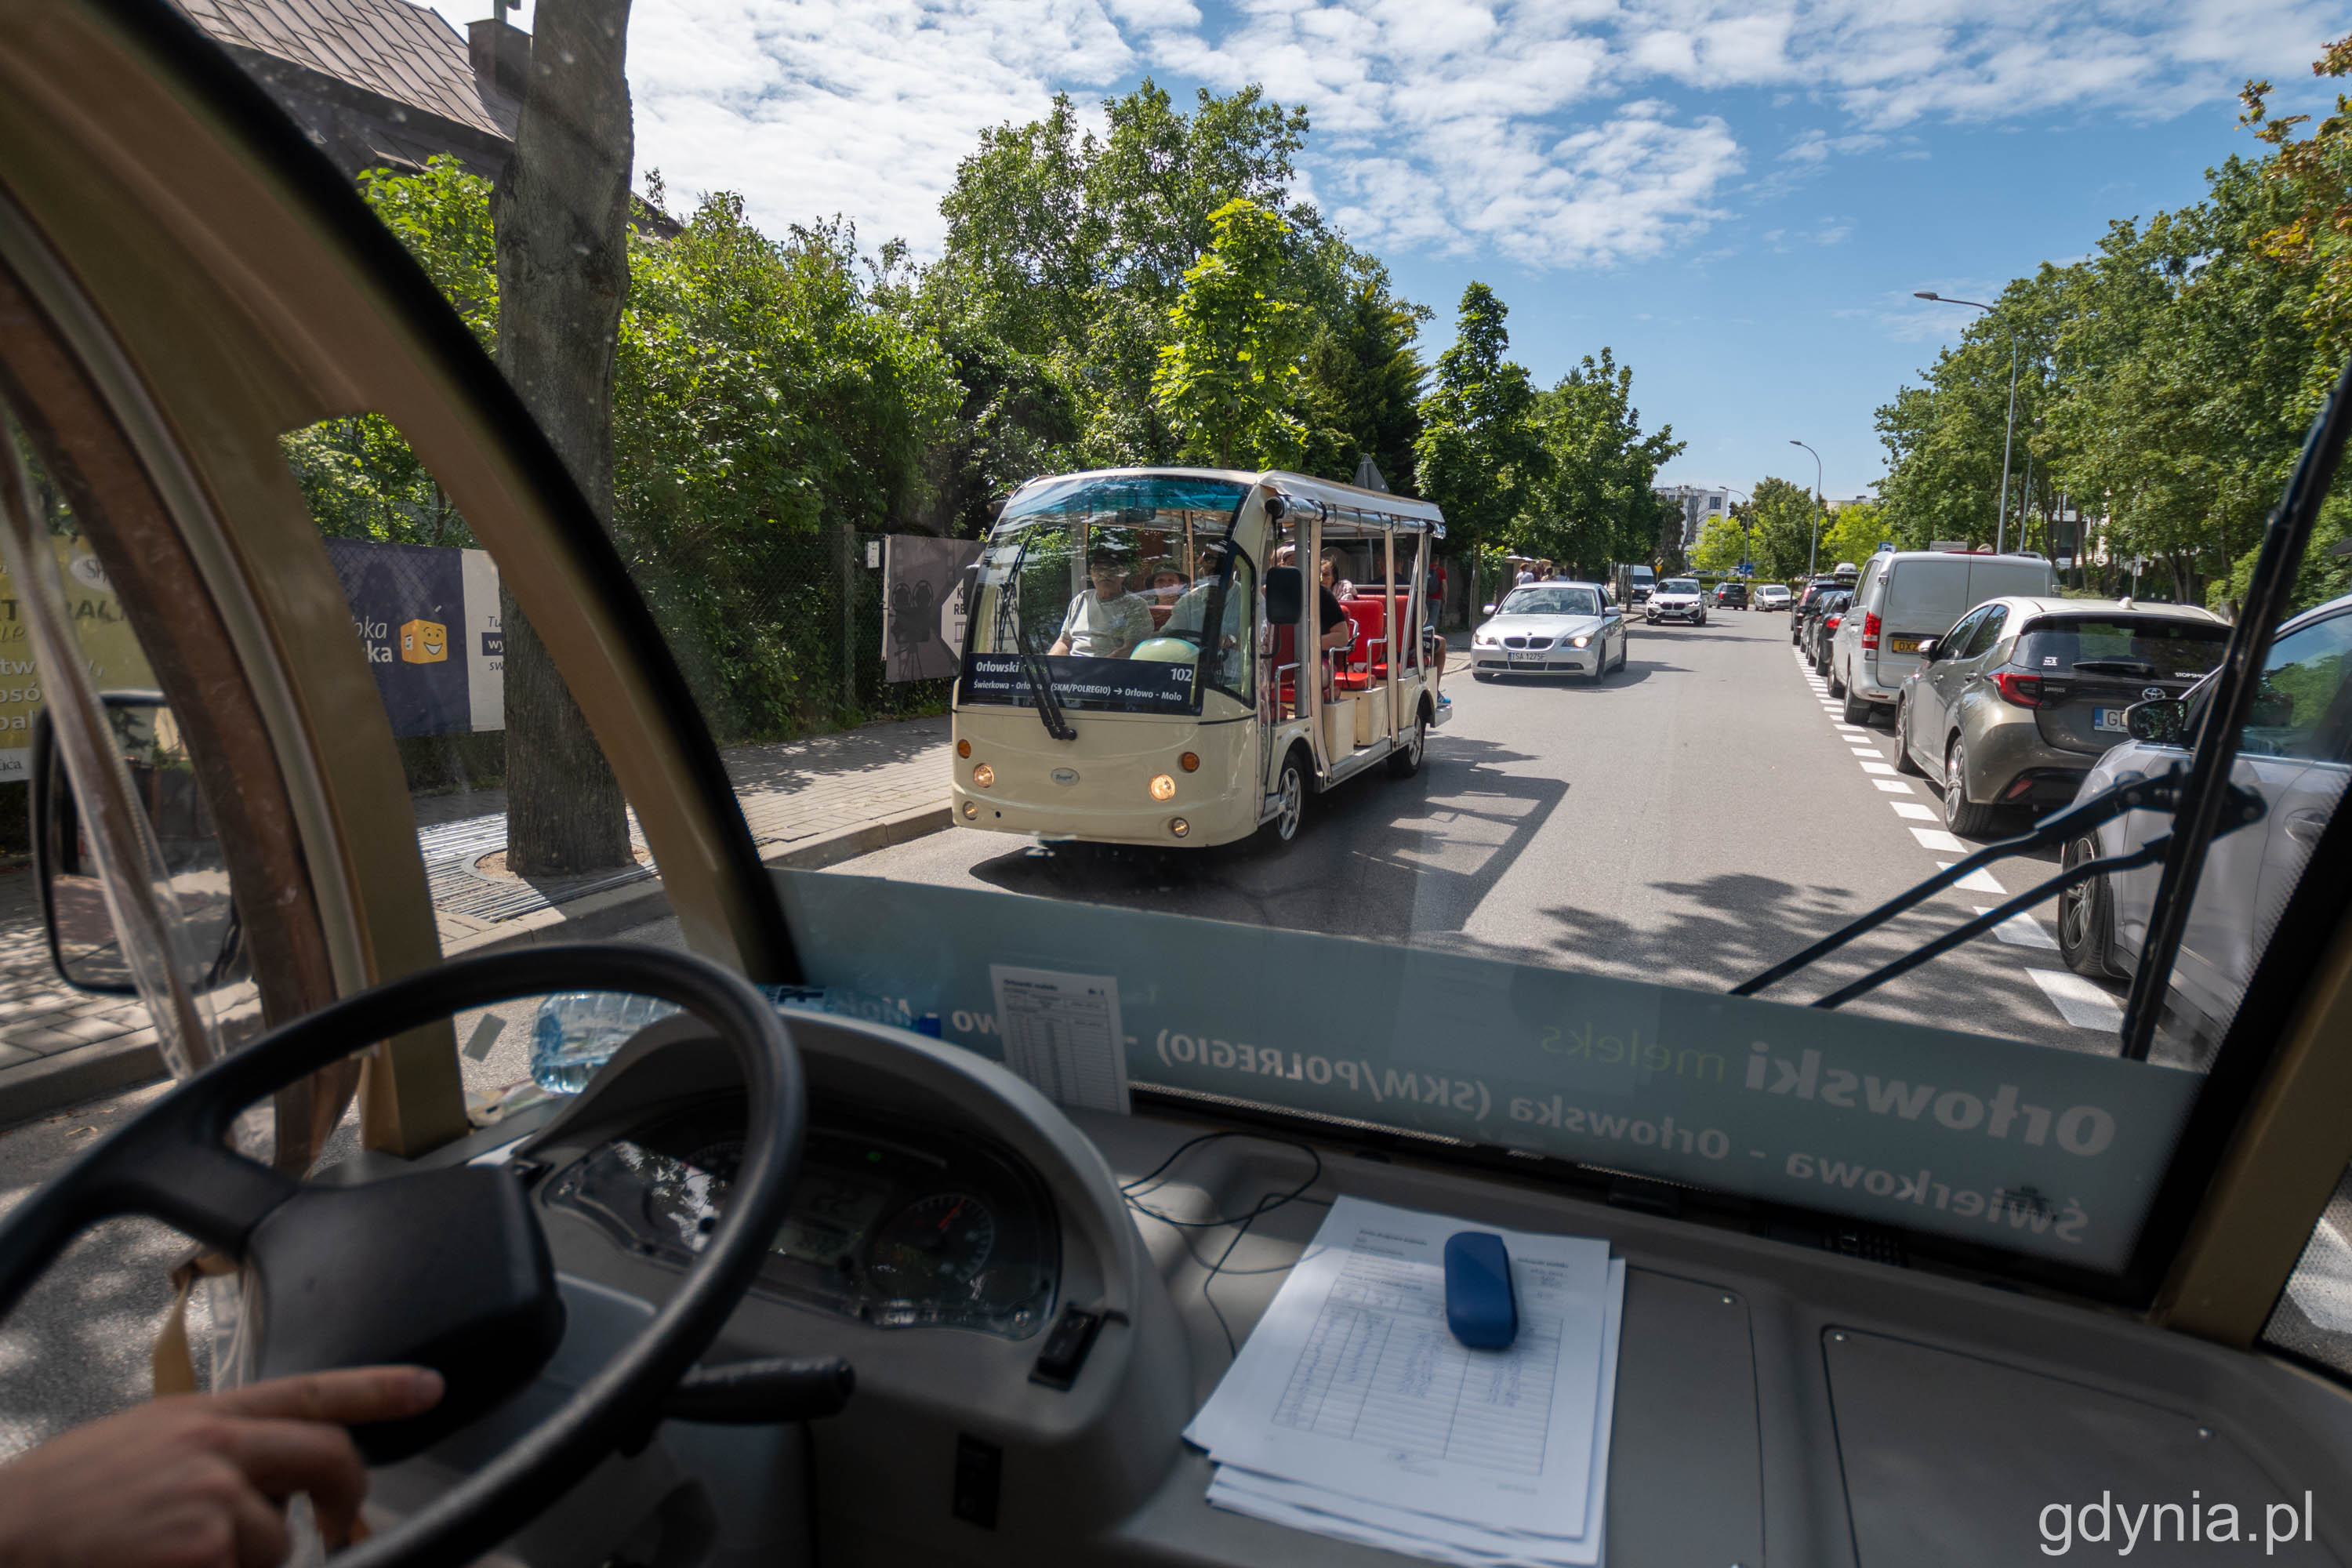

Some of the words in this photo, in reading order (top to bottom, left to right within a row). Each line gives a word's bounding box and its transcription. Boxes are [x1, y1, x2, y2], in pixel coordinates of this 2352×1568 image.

[976, 660, 1019, 673] Orłowski
[1171, 668, 1192, 681] 102
[974, 679, 1009, 689] Świerkowa
[1051, 682, 1111, 696] (SKM/POLREGIO)
[1125, 688, 1153, 699] Orłowo
[1161, 691, 1182, 701] Molo
